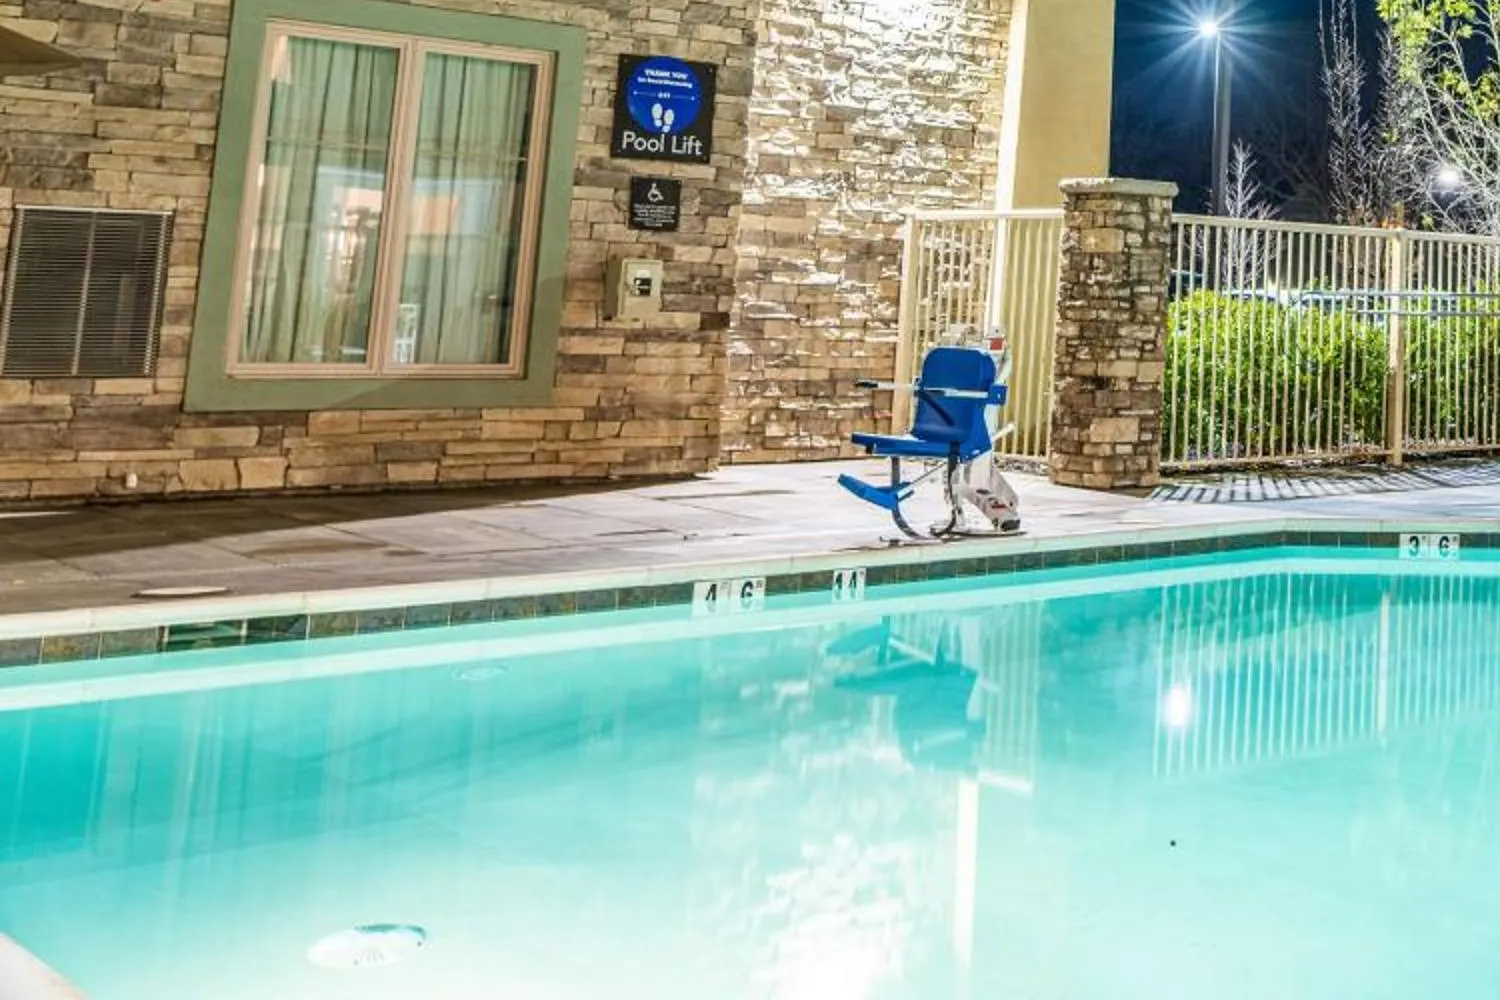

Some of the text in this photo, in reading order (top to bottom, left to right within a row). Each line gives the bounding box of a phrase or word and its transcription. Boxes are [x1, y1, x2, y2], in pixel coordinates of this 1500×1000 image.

[671, 71, 688, 80] YOU
[622, 131, 703, 156] Pool Lift
[1409, 535, 1449, 556] 3 6
[741, 581, 753, 604] 6
